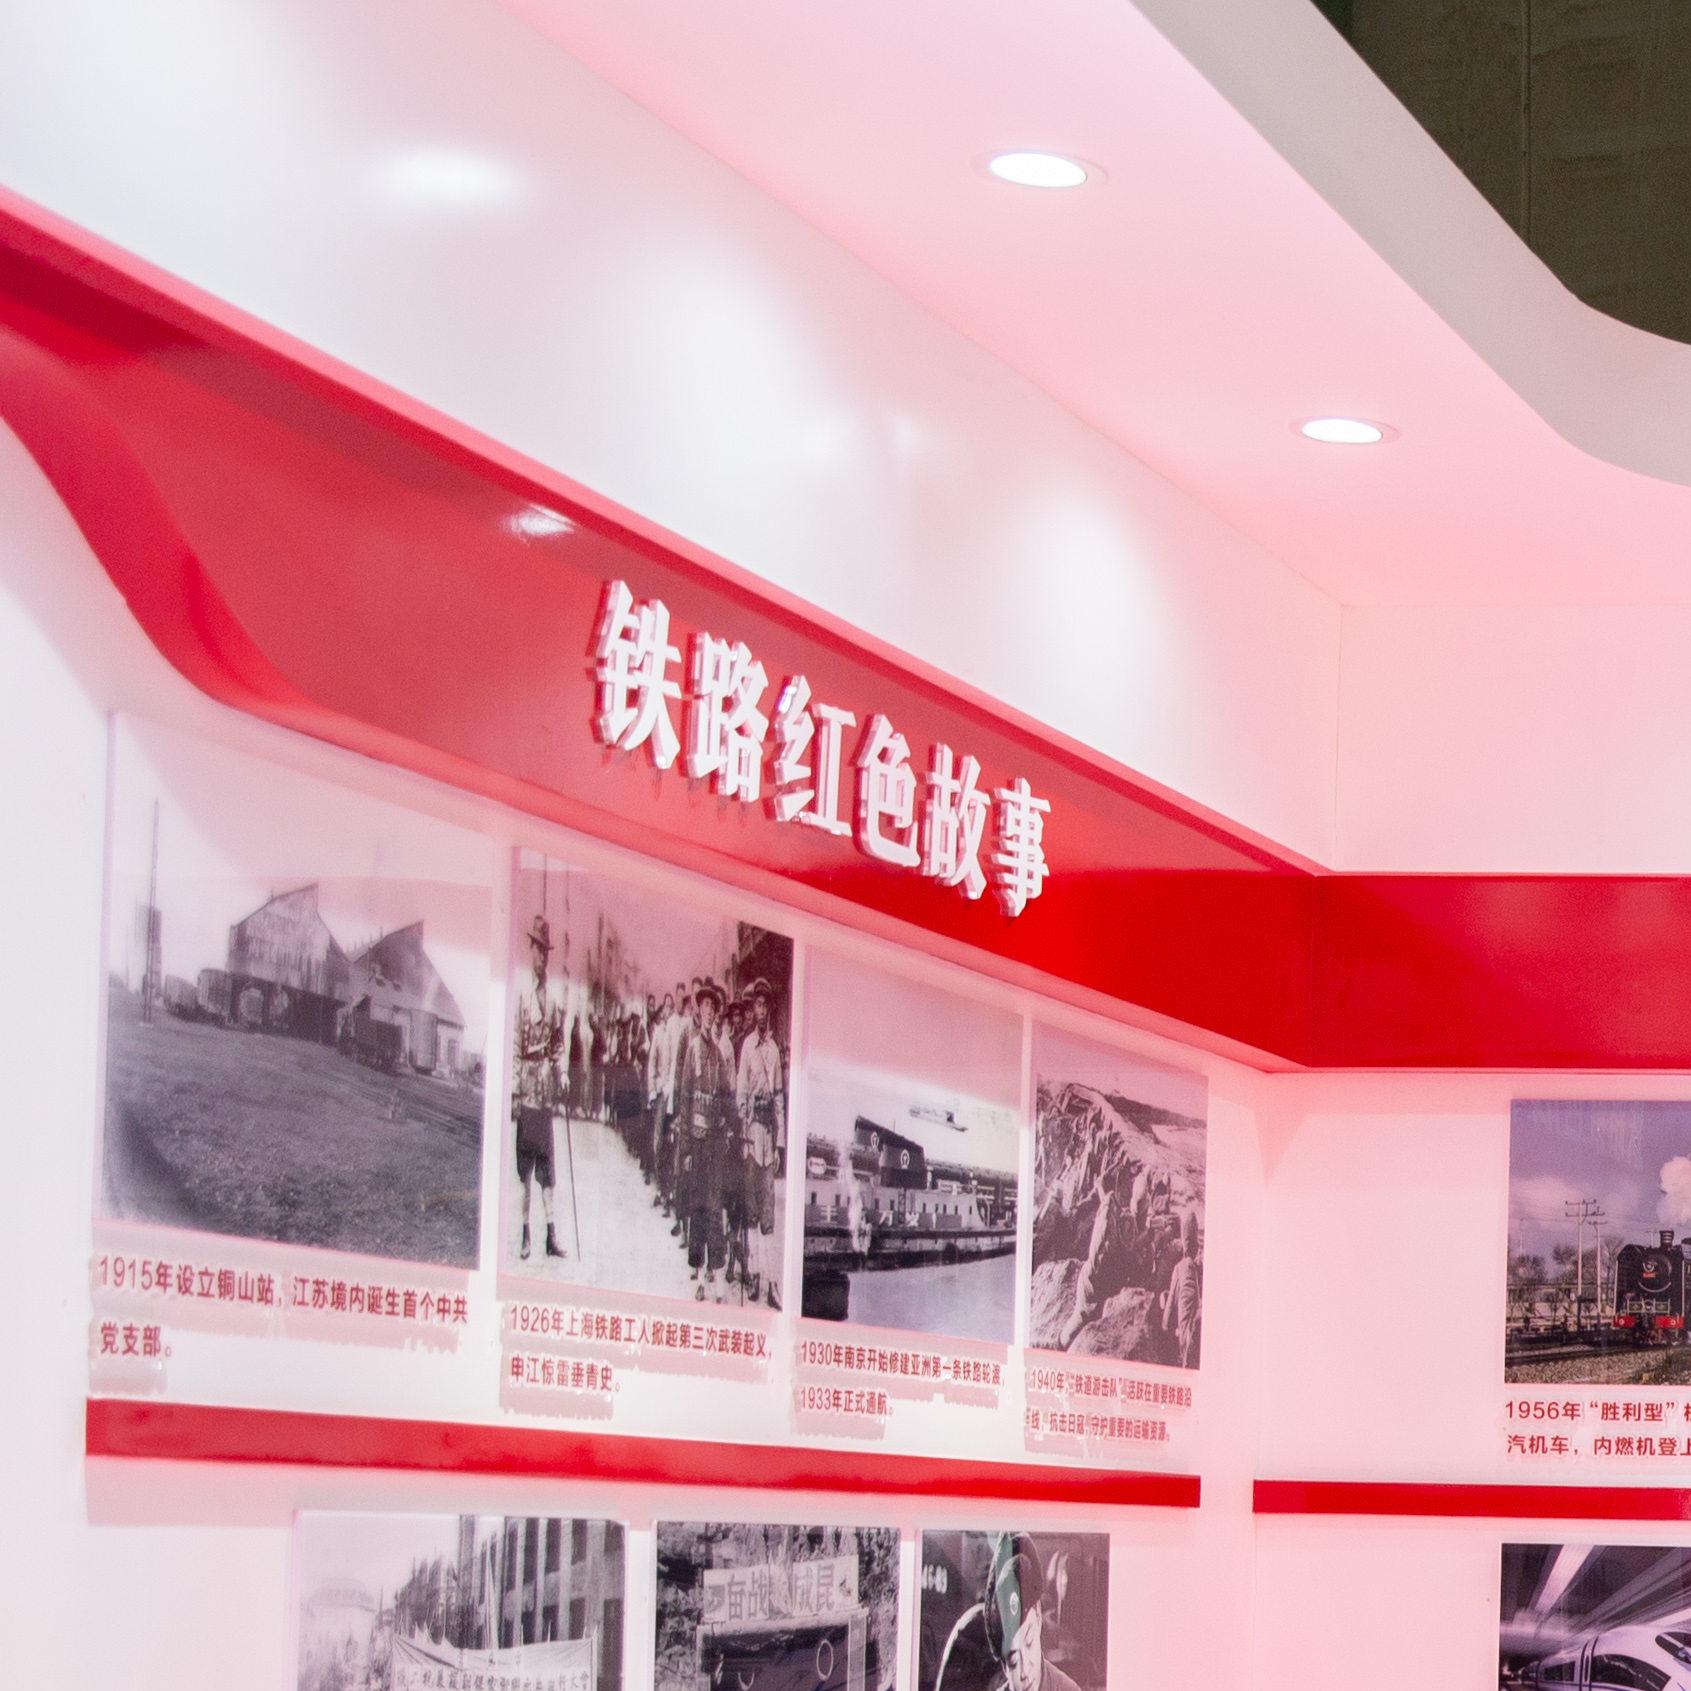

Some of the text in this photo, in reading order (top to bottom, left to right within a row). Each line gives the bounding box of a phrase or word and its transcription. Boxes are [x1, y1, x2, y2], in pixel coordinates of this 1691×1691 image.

[596, 580, 1051, 917] 铁路红色故事
[99, 1255, 469, 1325] 1915年设立铜山站，江苏境内诞生首个中共
[100, 1321, 172, 1358] 党支部。
[510, 1304, 772, 1360] 1926年上海铁路工人掀起第三次武装起义，
[510, 1353, 621, 1393] 申江惊雷垂青史。
[800, 1386, 893, 1416] 1933年正式通航。
